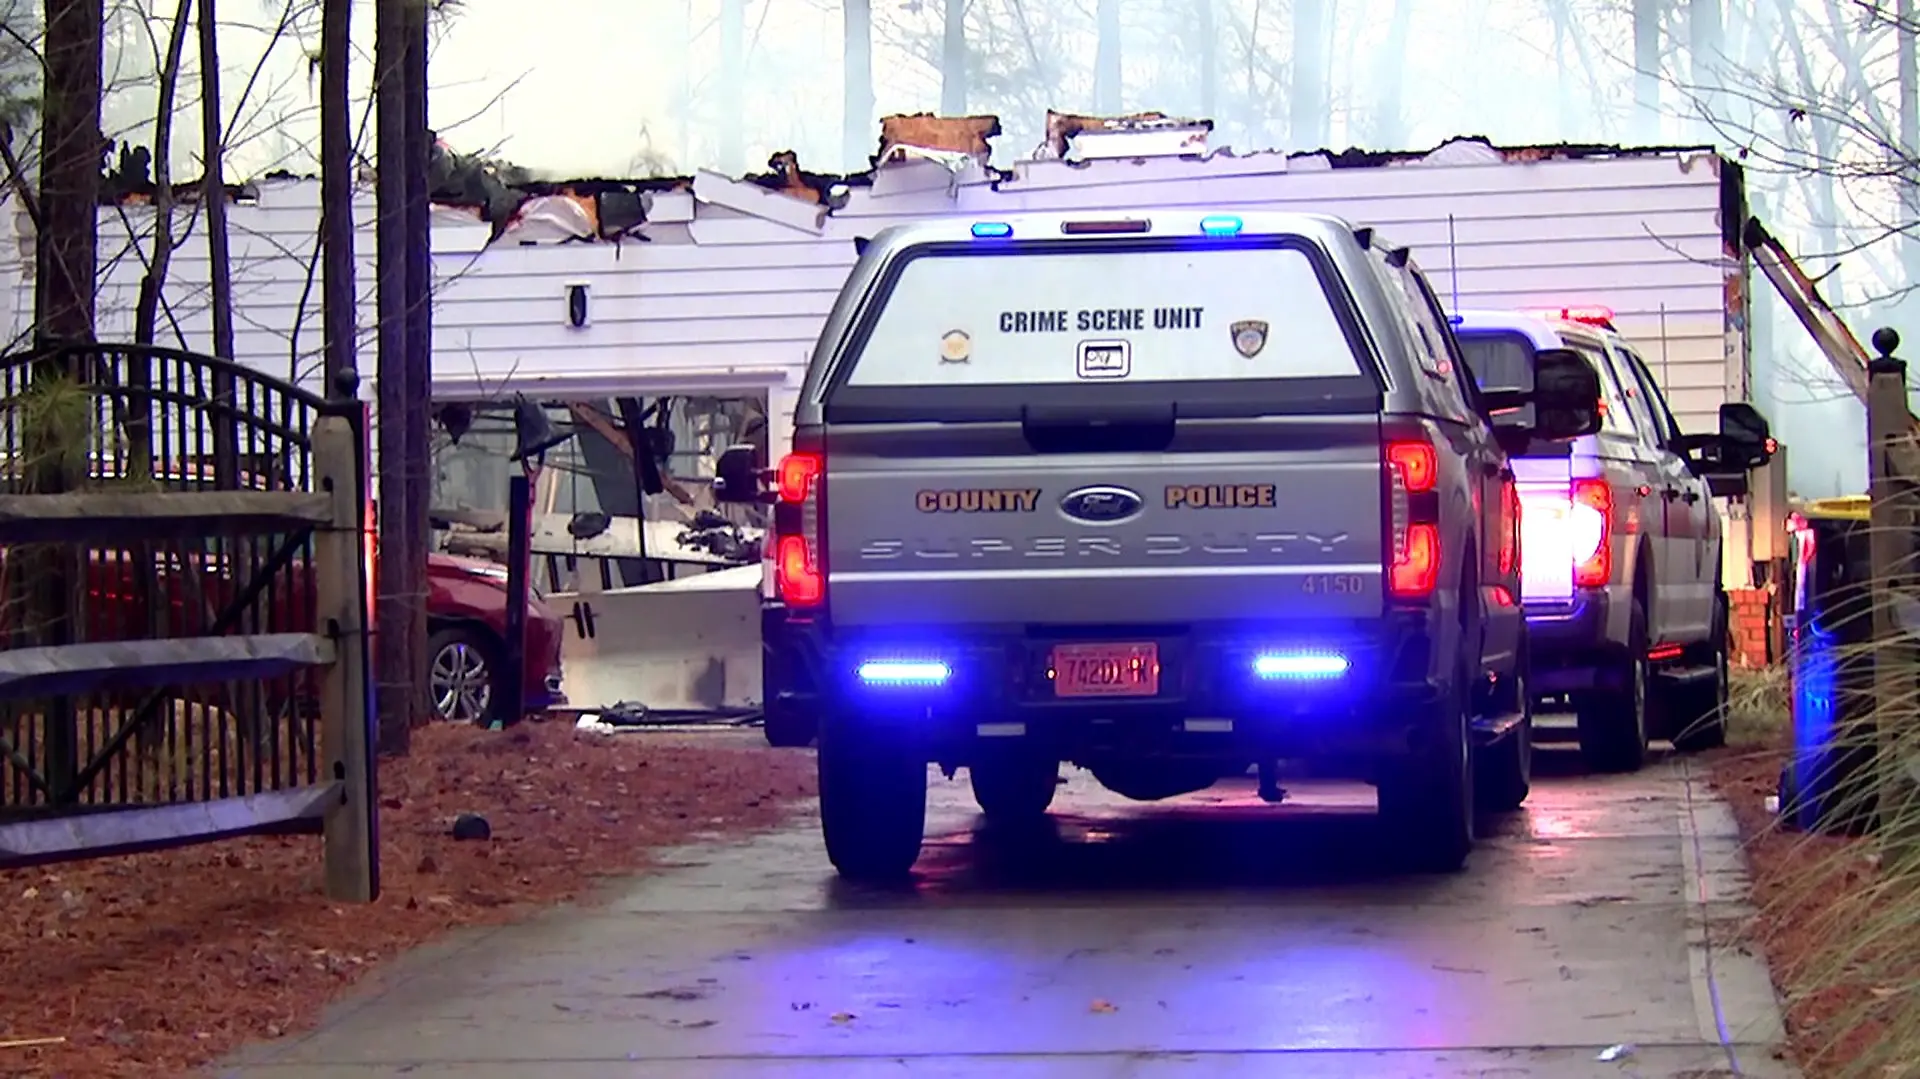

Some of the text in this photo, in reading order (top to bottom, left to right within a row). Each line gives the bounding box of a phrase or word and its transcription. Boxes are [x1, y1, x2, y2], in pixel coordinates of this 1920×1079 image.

[1000, 307, 1205, 332] CRIME SCENE UNIT
[916, 484, 1277, 512] COUNTY POLICE
[860, 532, 1350, 559] SUPER DUTY
[1301, 575, 1363, 595] 4150
